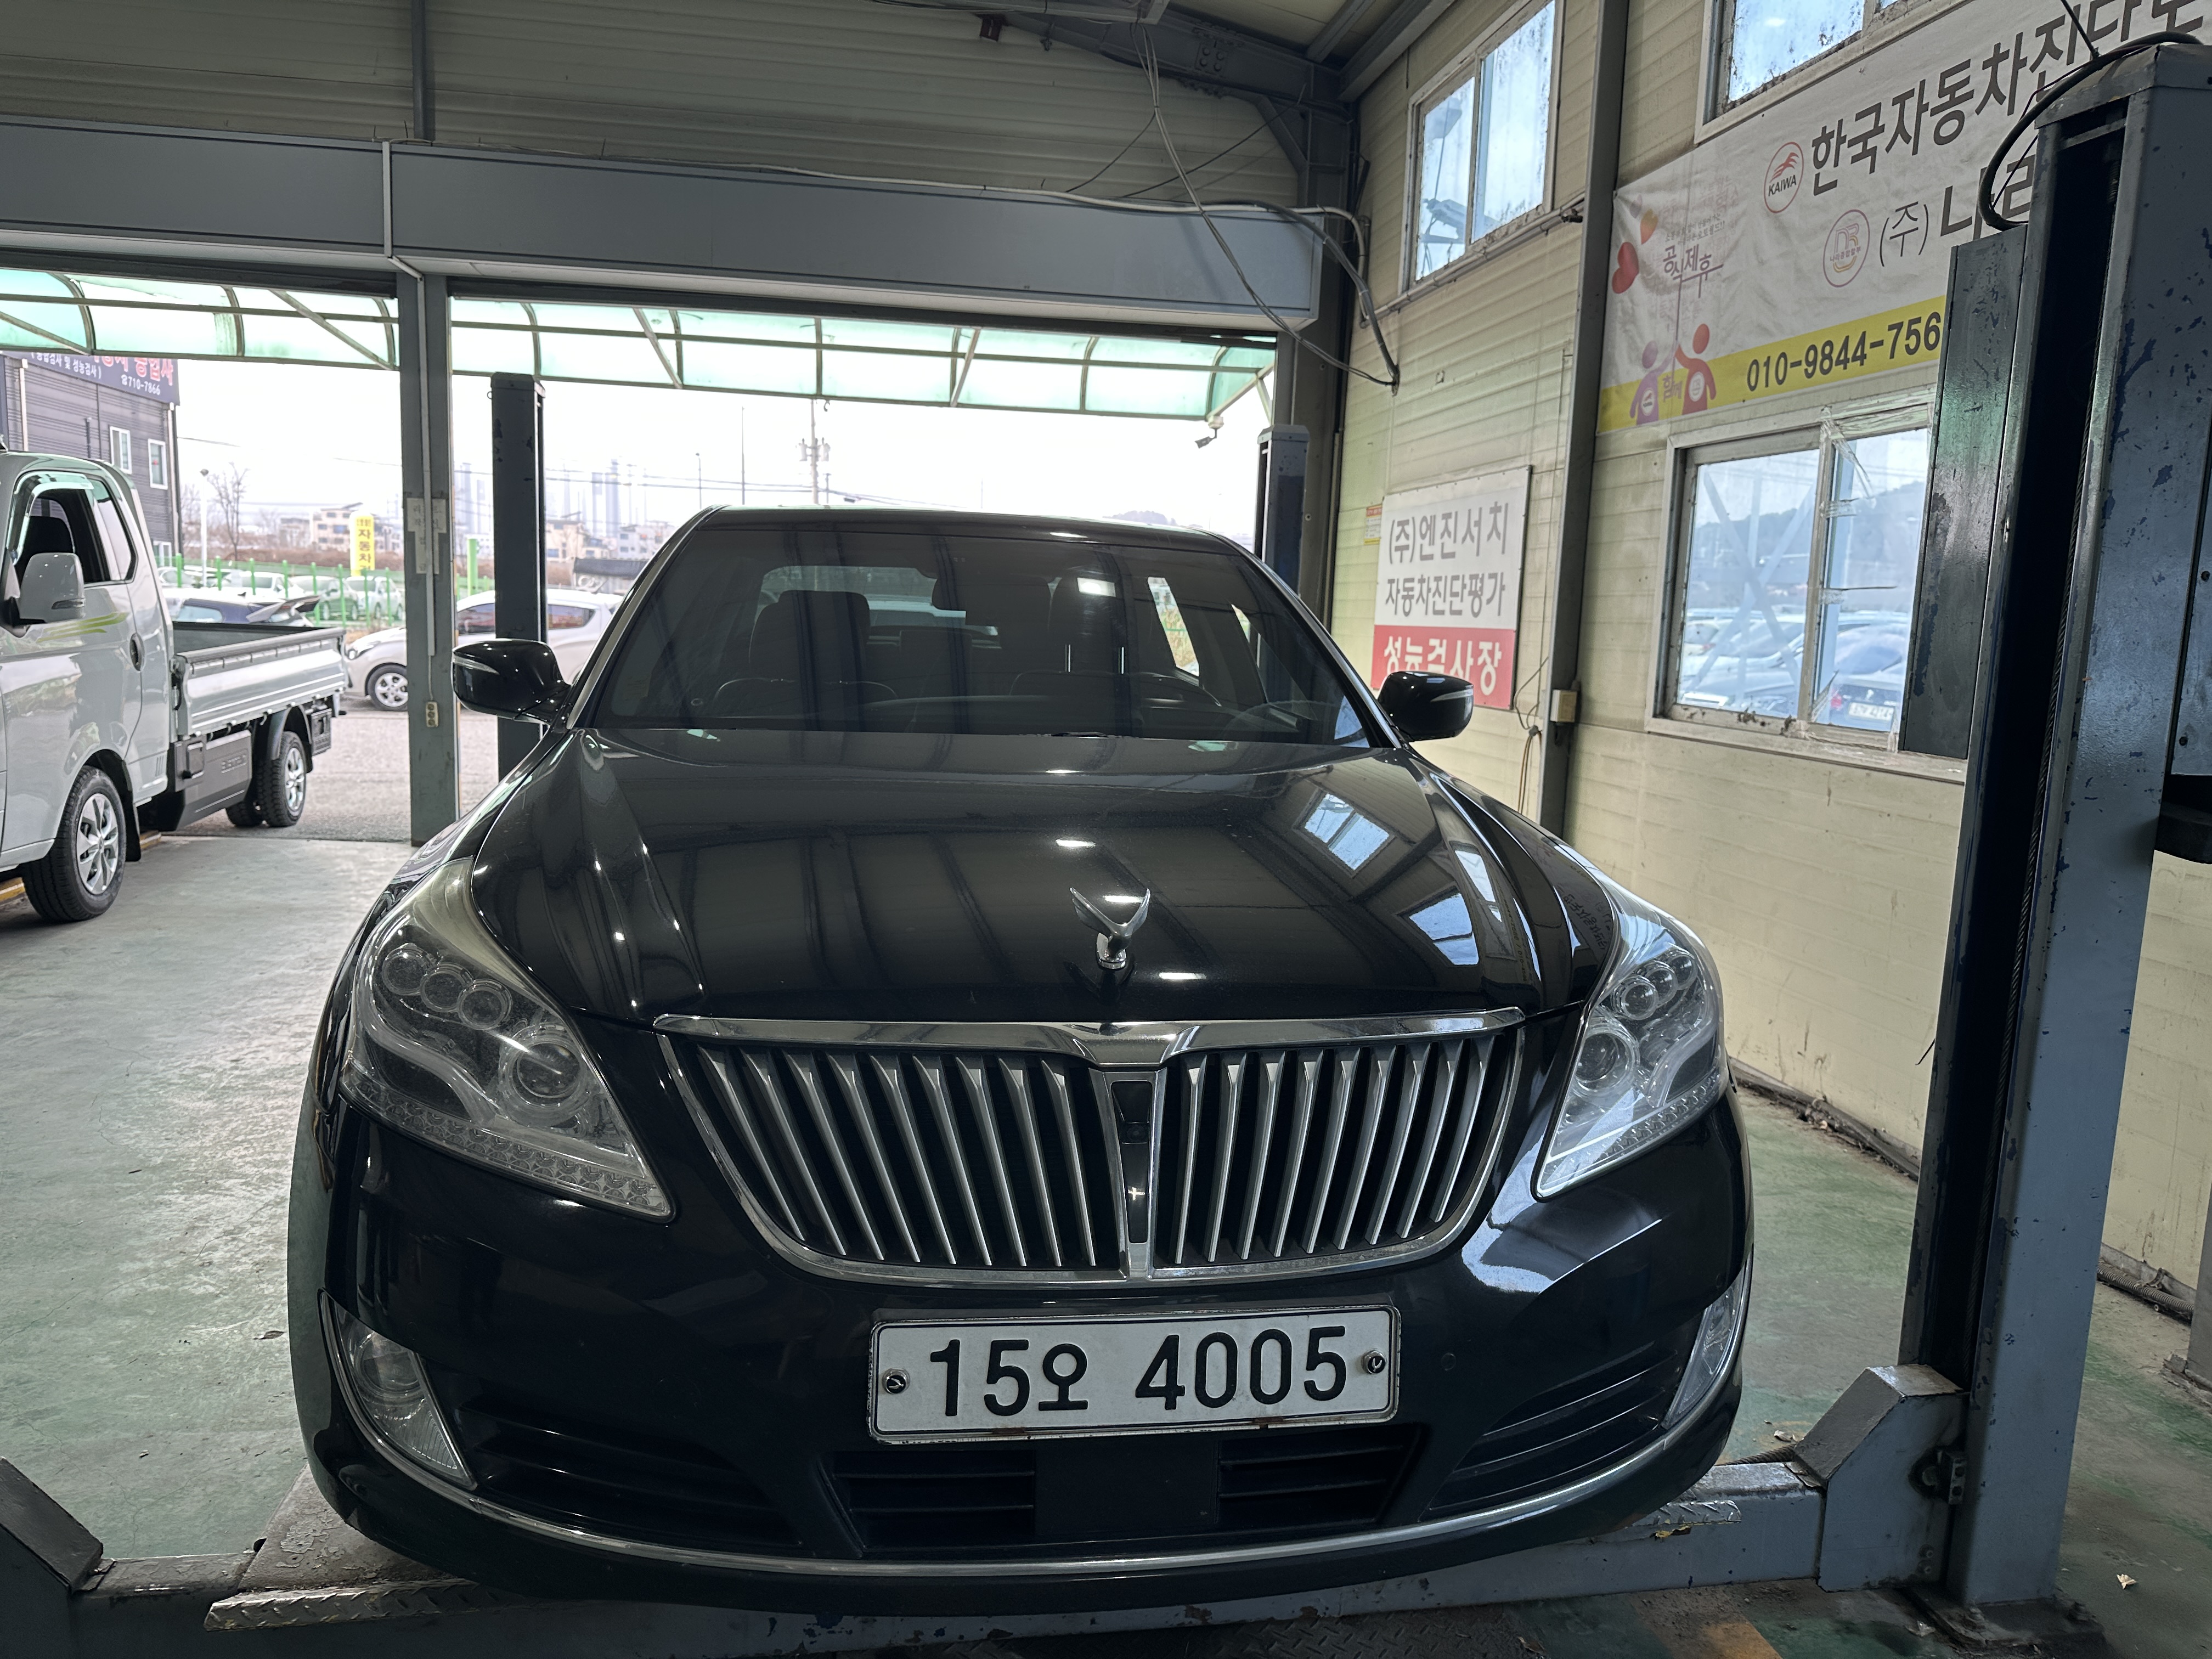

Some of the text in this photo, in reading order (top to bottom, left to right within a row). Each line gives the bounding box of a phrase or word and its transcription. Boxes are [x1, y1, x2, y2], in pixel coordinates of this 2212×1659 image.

[1768, 174, 1797, 196] KAIWA
[1880, 201, 1929, 267] (주)
[1389, 501, 1509, 564] (주)엔진서치
[1385, 572, 1505, 618] 자동차진단평가
[1384, 635, 1503, 696] 성능검사장
[929, 1325, 1347, 1417] 15오 4005
